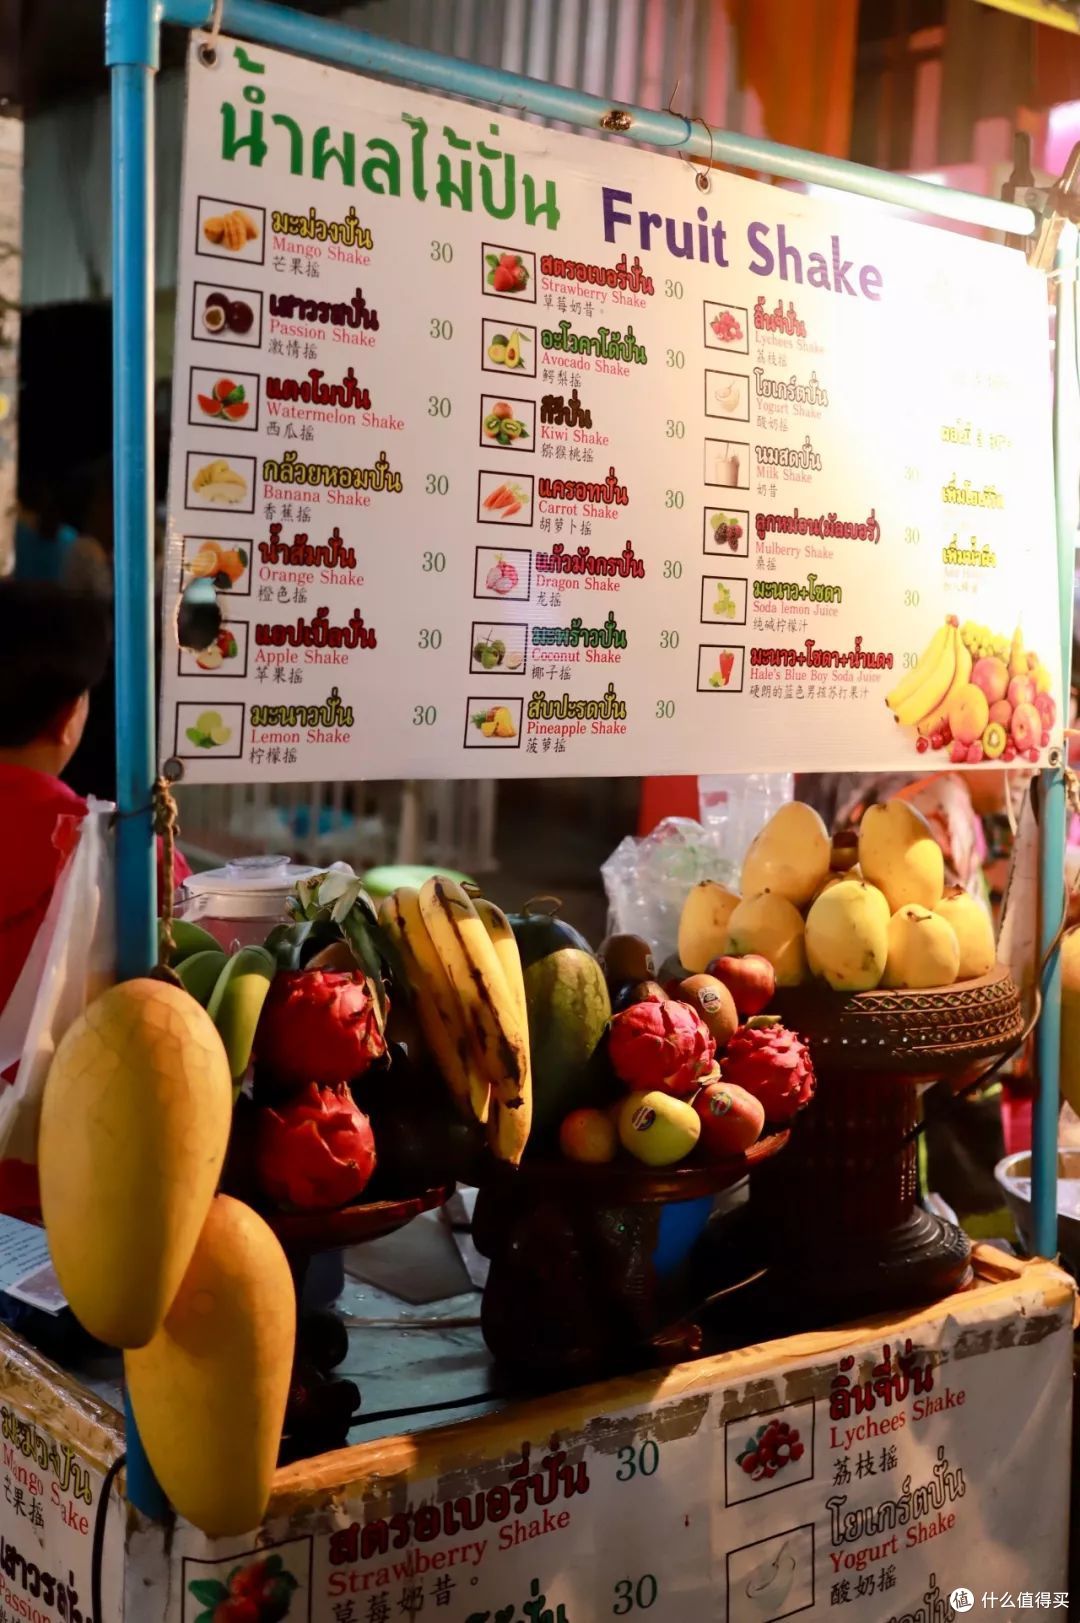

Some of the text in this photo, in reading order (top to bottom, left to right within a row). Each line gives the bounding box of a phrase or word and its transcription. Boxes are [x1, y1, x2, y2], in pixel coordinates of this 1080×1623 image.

[220, 46, 561, 231] น้ำผลไม้ปั่น
[271, 206, 374, 250] มะม่วงปั่น
[272, 236, 371, 266] Mango Shake
[430, 240, 454, 263] 30
[602, 186, 883, 301] Fruit Shake
[272, 255, 320, 278] 芒果摇
[540, 253, 655, 296] สตรอเบอรี่ปั่น
[541, 278, 646, 309] Strawberry Shake
[665, 279, 684, 300] 30
[270, 318, 376, 347] Passion Shake
[430, 318, 454, 340] 30
[541, 320, 647, 365] อะโวคาโด้ปั่น
[541, 352, 630, 377] Avocado Shake
[666, 349, 685, 369] 30
[266, 367, 371, 410] แตงโมปั่น
[267, 401, 405, 431] Watermelon Shake
[428, 396, 452, 418] 30
[756, 398, 822, 419] Yogurt Shake
[266, 421, 314, 442] 西瓜摇
[541, 426, 609, 446] Kiwi Shake
[666, 419, 685, 439] 30
[755, 435, 822, 471] นมสดปั่น
[263, 451, 403, 494] กล้วยหอมปั่น
[756, 466, 813, 483] Milk Shake
[263, 484, 371, 507] Banana Shake
[425, 474, 449, 495] 30
[538, 466, 629, 506] แครอทปั่น
[539, 500, 618, 519] Carrot Shake
[665, 490, 684, 509] 30
[264, 503, 312, 523] 香蕉摇
[540, 517, 592, 536] 胡萝卜摇
[904, 527, 920, 545] 30
[535, 540, 645, 578] แก้วมังกรปั่น
[755, 541, 834, 560] Mulberry Shake
[422, 551, 446, 573] 30
[663, 560, 682, 579] 30
[259, 567, 364, 586] Orange Shake
[536, 575, 621, 592] Dragon Shake
[258, 585, 308, 604] 橙色摇
[753, 573, 842, 604] มะนาว+โซดา
[904, 589, 919, 607] 30
[753, 602, 839, 617] Soda lemon Juice
[418, 628, 442, 650] 30
[531, 611, 627, 649] มะพร้าวปั่น
[660, 630, 679, 649] 30
[255, 649, 349, 666] Apple Shake
[532, 648, 621, 663] Coconut Shake
[751, 636, 893, 670] มะนาว+โซดา+น้ำแดง
[902, 653, 918, 670] 30
[255, 666, 303, 684] 苹果摇
[532, 665, 572, 680] 椰子摇
[751, 668, 882, 683] Hale's Blue Boy Soda Juice
[250, 686, 354, 728] มะนาวปั่น
[527, 682, 627, 720] สับปะรดปั่น
[656, 700, 675, 718] 30
[413, 706, 437, 726] 30
[251, 729, 350, 744] Lemon Shake
[527, 721, 626, 737] Pineapple Shake
[250, 747, 297, 764] 柠檬摇
[526, 738, 566, 753] 菠萝摇
[830, 1388, 965, 1450] Lychees Shake
[615, 1440, 660, 1482] 30
[832, 1445, 898, 1486] 荔枝摇
[328, 1508, 570, 1597] Strawberry Shake
[829, 1510, 956, 1574] Yogurt Shake
[613, 1574, 658, 1615] 30
[831, 1564, 897, 1606] 酸奶摇
